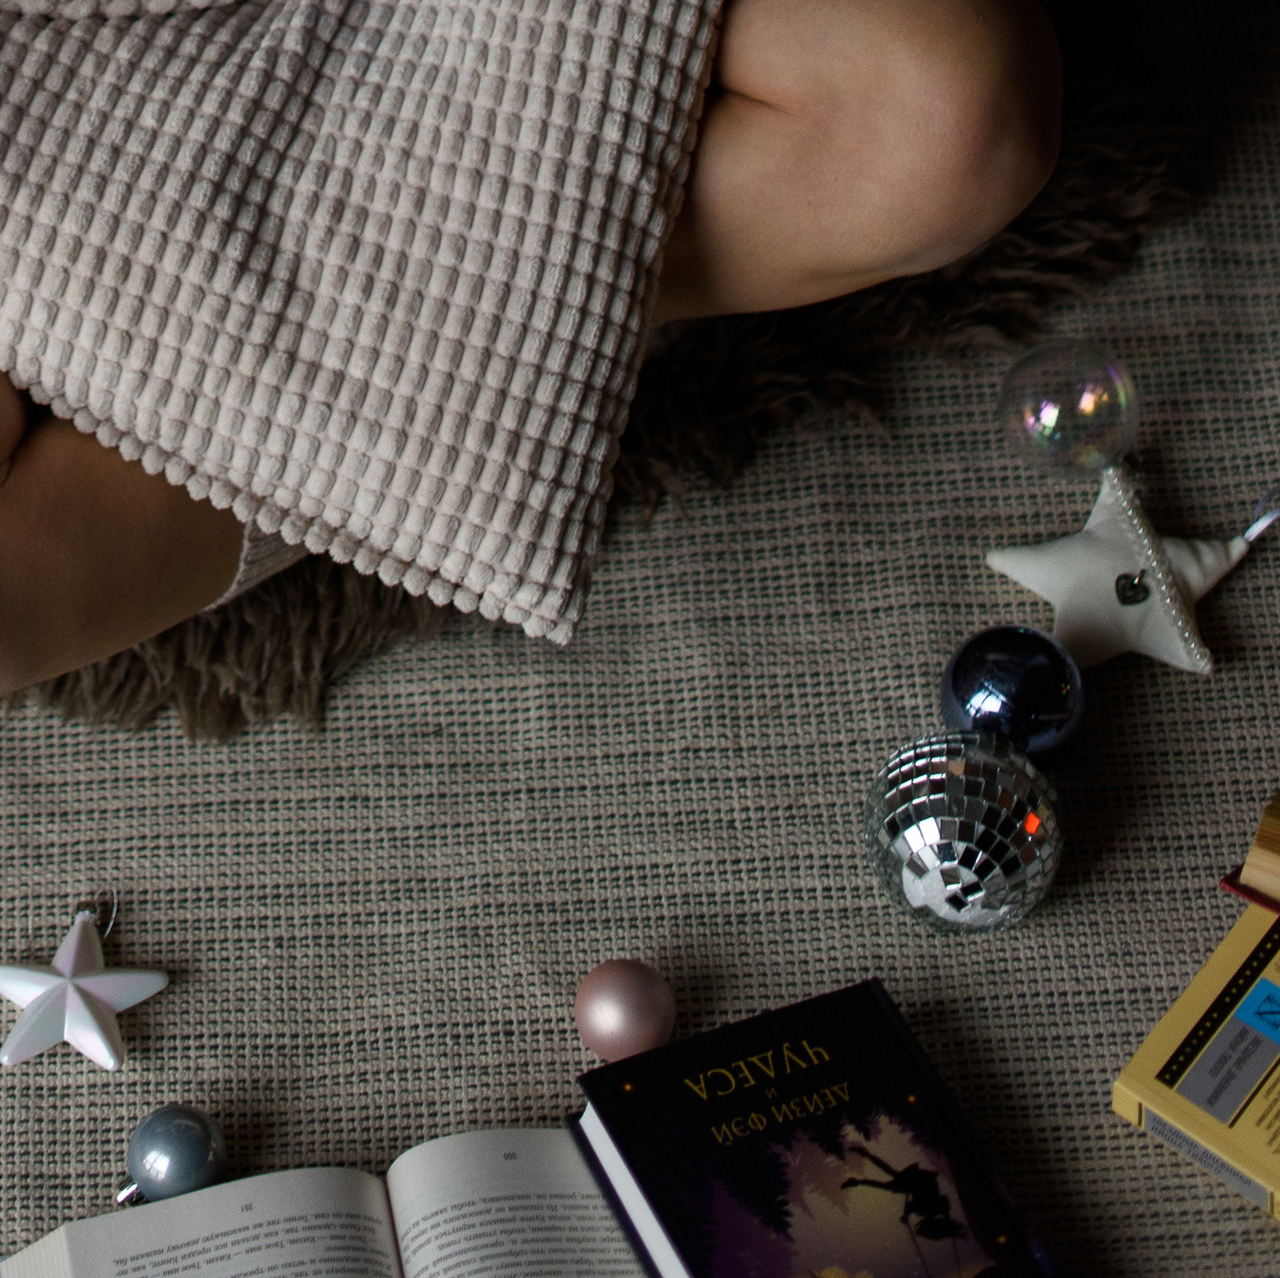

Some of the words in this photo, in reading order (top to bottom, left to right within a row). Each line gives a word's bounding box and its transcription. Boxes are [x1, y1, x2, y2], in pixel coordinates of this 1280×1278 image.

[684, 1040, 831, 1102] ЧУДЕСА
[771, 1081, 851, 1125] ДЕЙЗИ
[711, 1111, 768, 1146] ФЭЙ
